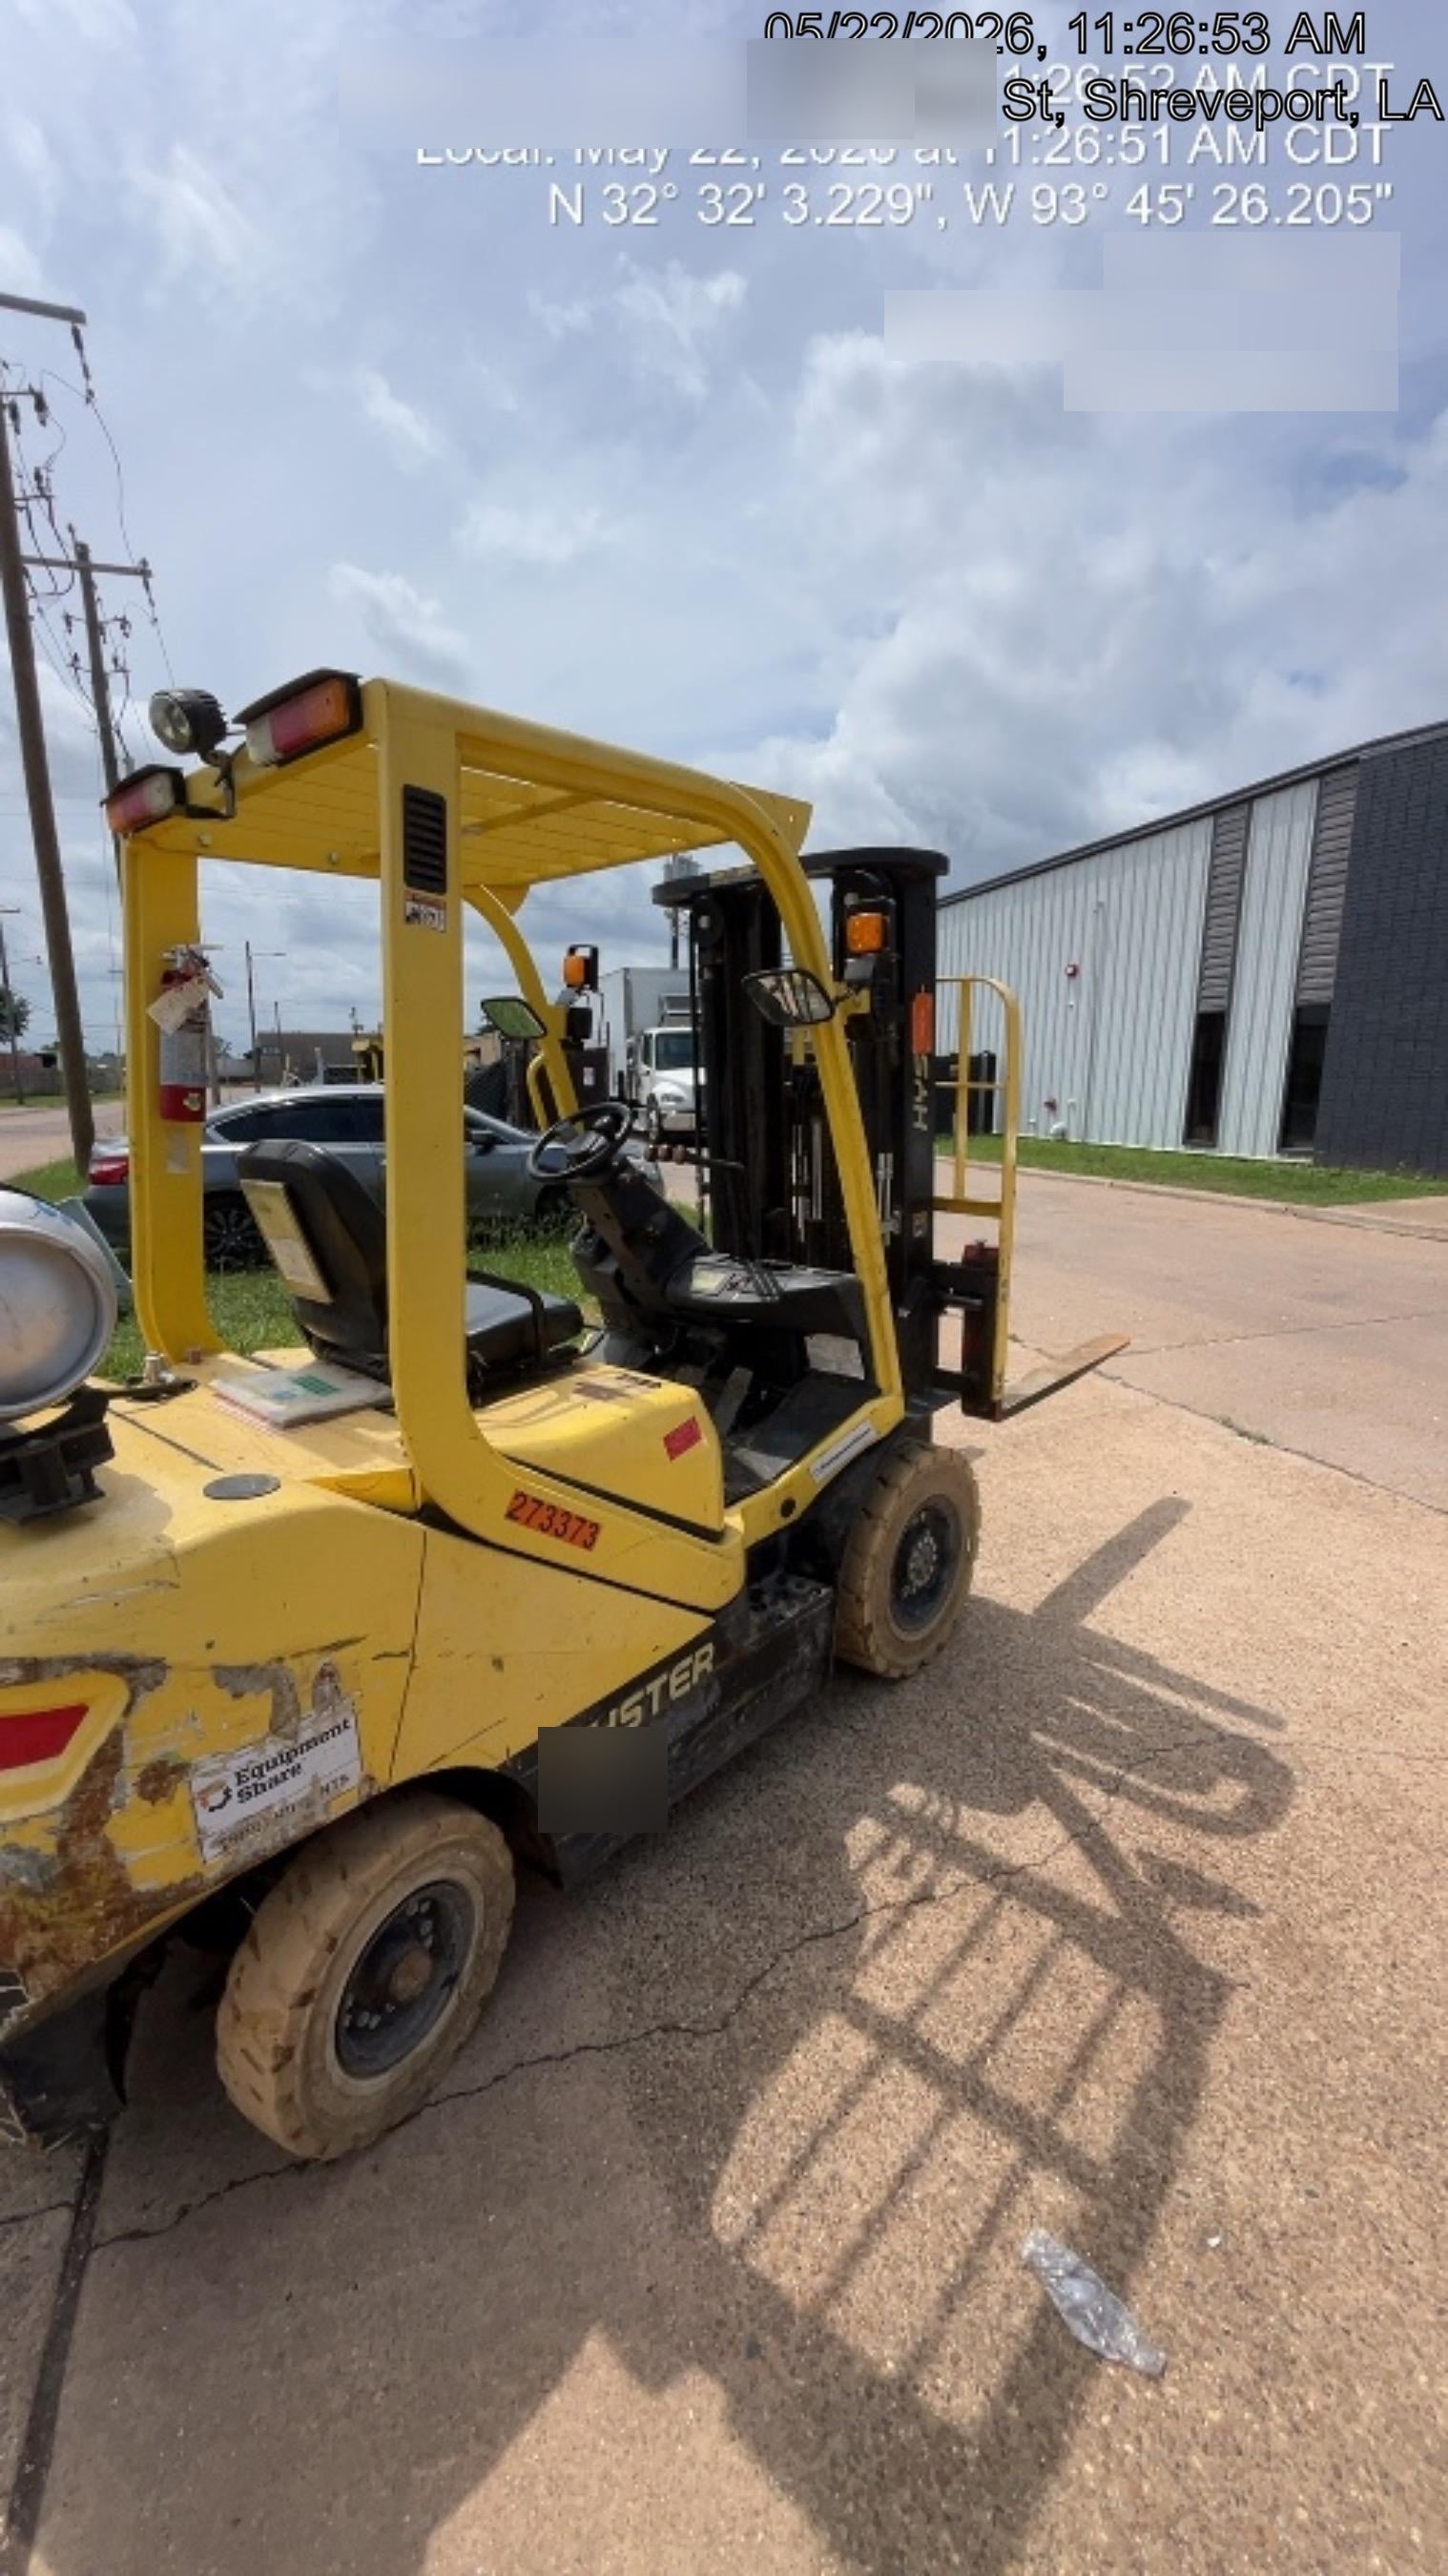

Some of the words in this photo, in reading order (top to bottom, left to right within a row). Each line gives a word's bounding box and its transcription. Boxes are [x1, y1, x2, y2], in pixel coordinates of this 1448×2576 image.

[506, 1490, 601, 1551] 273373
[234, 1717, 352, 1787] Equipment
[236, 1762, 303, 1804] Share
